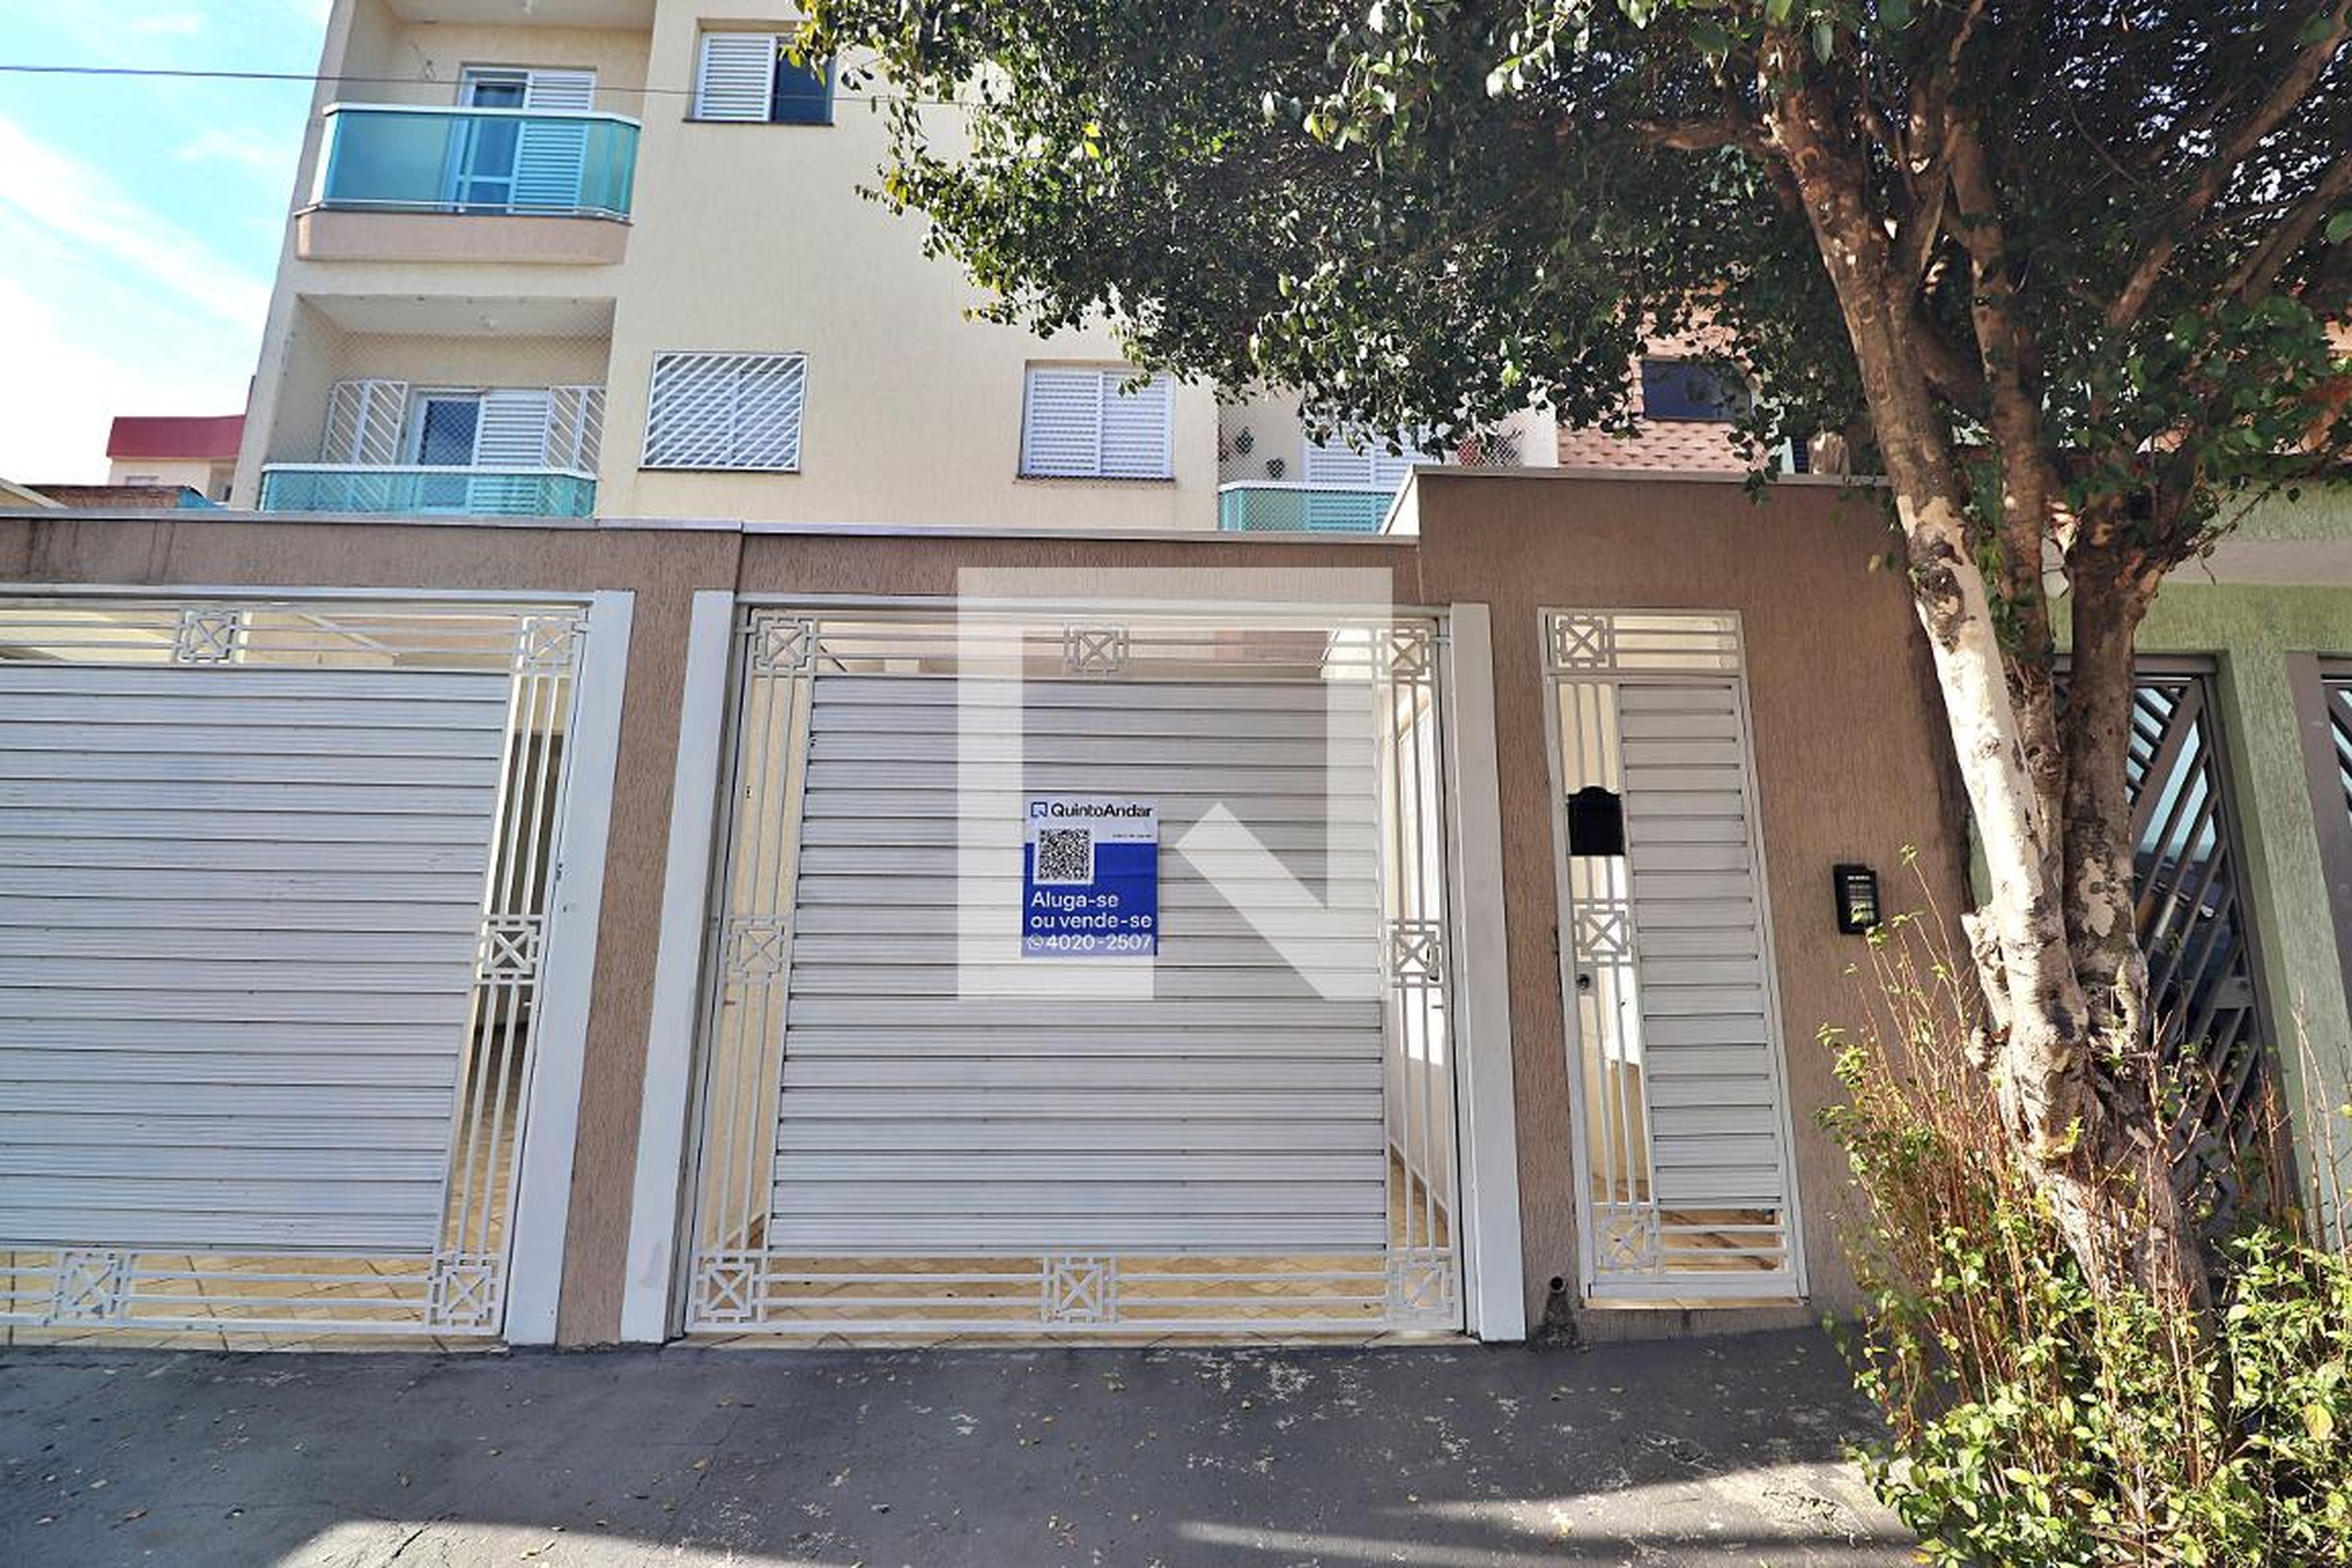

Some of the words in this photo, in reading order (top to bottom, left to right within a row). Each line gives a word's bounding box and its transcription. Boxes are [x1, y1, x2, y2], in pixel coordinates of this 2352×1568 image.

[1050, 802, 1152, 818] QuintoAndar
[1031, 891, 1118, 911] Aluga-se
[1030, 915, 1054, 928] ou
[1060, 913, 1152, 928] vende-se
[1046, 934, 1152, 951] 4020-2507
